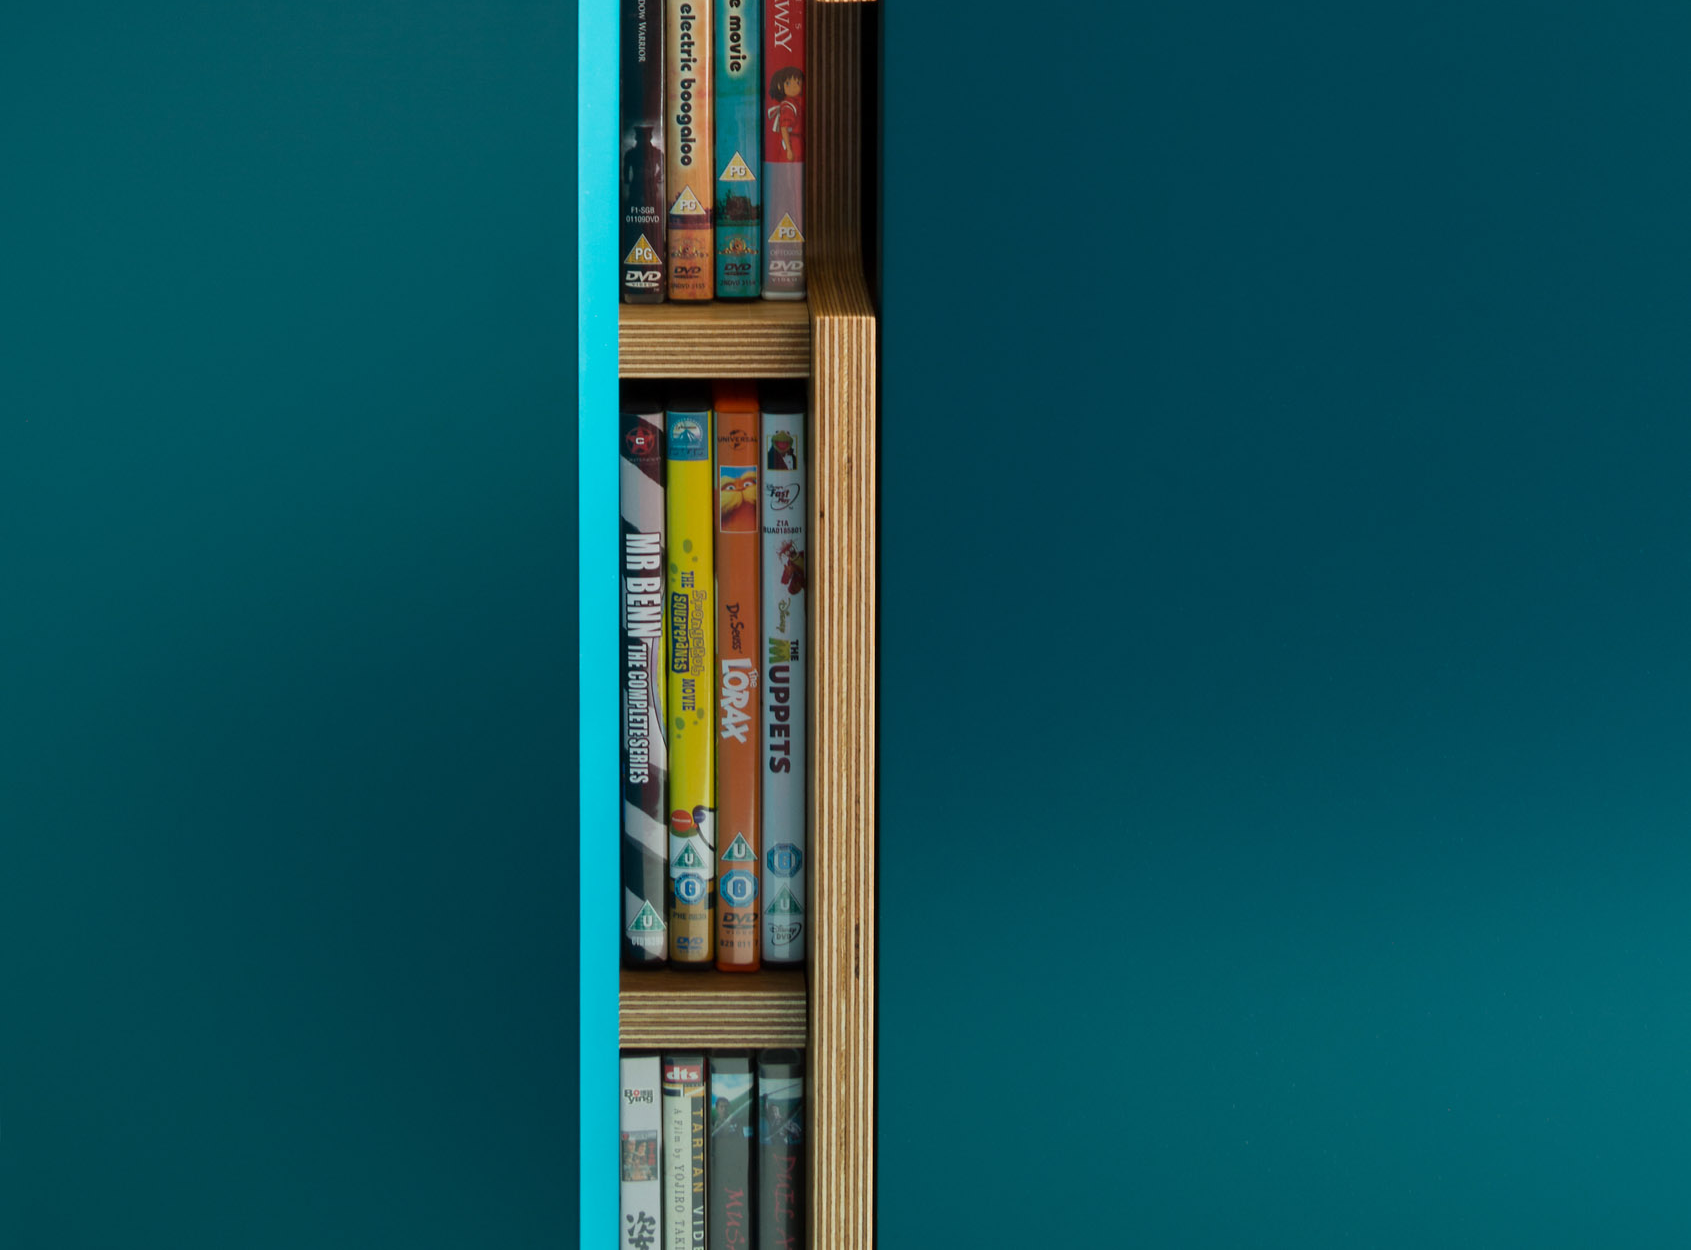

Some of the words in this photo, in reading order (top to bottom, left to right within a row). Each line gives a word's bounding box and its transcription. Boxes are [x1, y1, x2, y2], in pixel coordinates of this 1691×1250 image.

[638, 22, 647, 62] WARRIOR
[680, 3, 697, 71] electric
[729, 15, 746, 72] movie
[677, 78, 696, 166] boogaloo
[730, 166, 746, 176] PG
[680, 201, 696, 210] PG
[779, 228, 795, 238] PG
[635, 248, 653, 260] PG
[770, 261, 803, 269] DVD
[626, 271, 661, 281] DVD
[626, 533, 660, 571] MR
[681, 570, 694, 588] THE
[625, 577, 661, 638] BENN
[726, 603, 741, 622] Dr.
[628, 644, 647, 667] THE
[791, 639, 799, 662] THE
[747, 668, 759, 688] The
[627, 671, 647, 737] COMPLETE
[682, 678, 696, 711] MOVIE
[720, 658, 753, 744] LORAX
[768, 638, 790, 774] MUPPETS
[628, 739, 648, 783] SERIES
[685, 854, 694, 864] U
[733, 844, 746, 858] U
[780, 898, 790, 910] U
[643, 916, 653, 927] U
[723, 913, 757, 922] DVD
[667, 1067, 698, 1080] dts
[693, 1109, 703, 1193] TARTAN
[675, 1165, 685, 1213] YOJIRO
